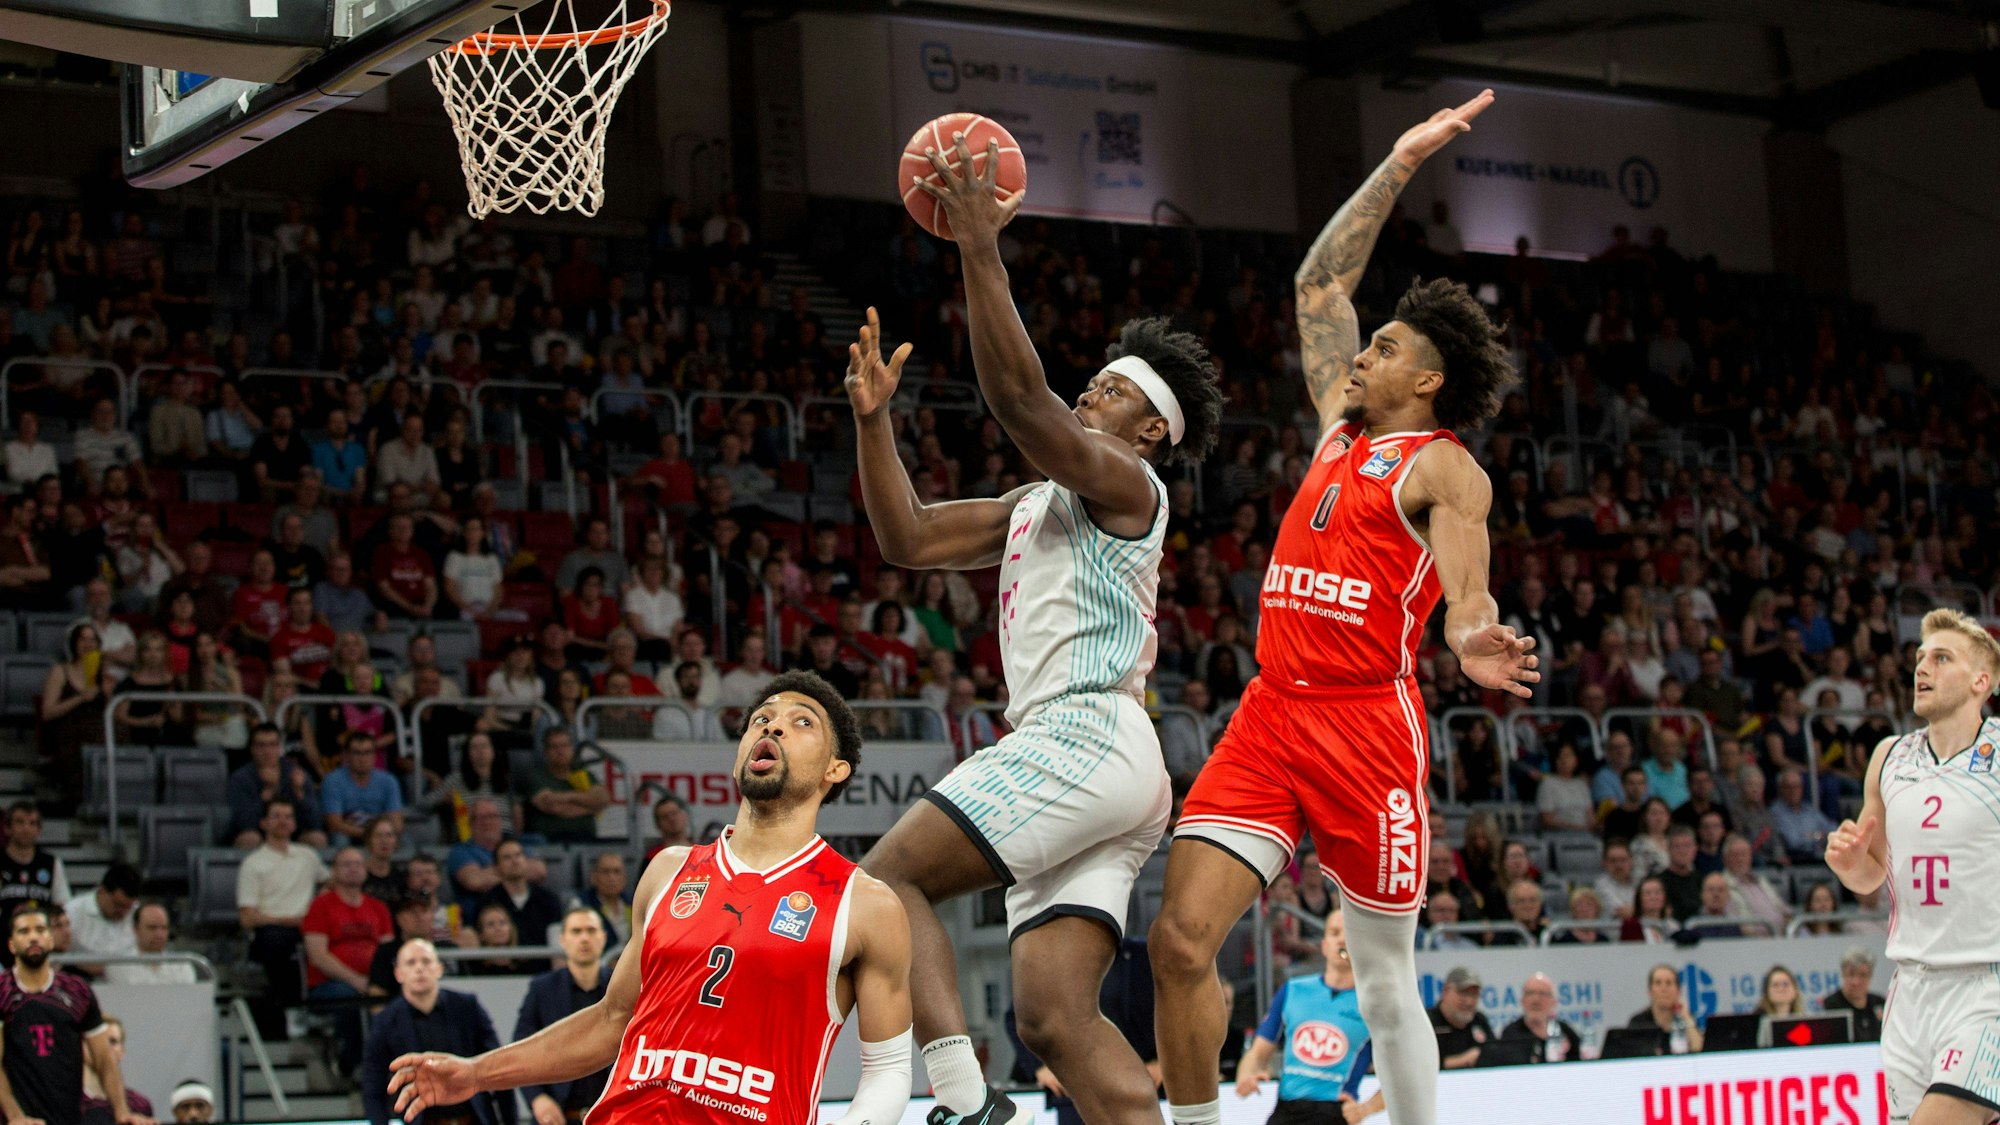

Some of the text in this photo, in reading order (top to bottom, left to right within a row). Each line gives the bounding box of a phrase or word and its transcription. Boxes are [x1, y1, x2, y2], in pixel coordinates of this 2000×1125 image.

[1310, 483, 1341, 531] 0
[1263, 555, 1372, 611] brose
[1921, 796, 1943, 829] 2
[774, 919, 801, 937] BBL
[698, 945, 735, 1008] 2
[629, 1035, 775, 1104] brose
[685, 1087, 767, 1122] Automobile
[1643, 1072, 1862, 1125] HEUTIGES
